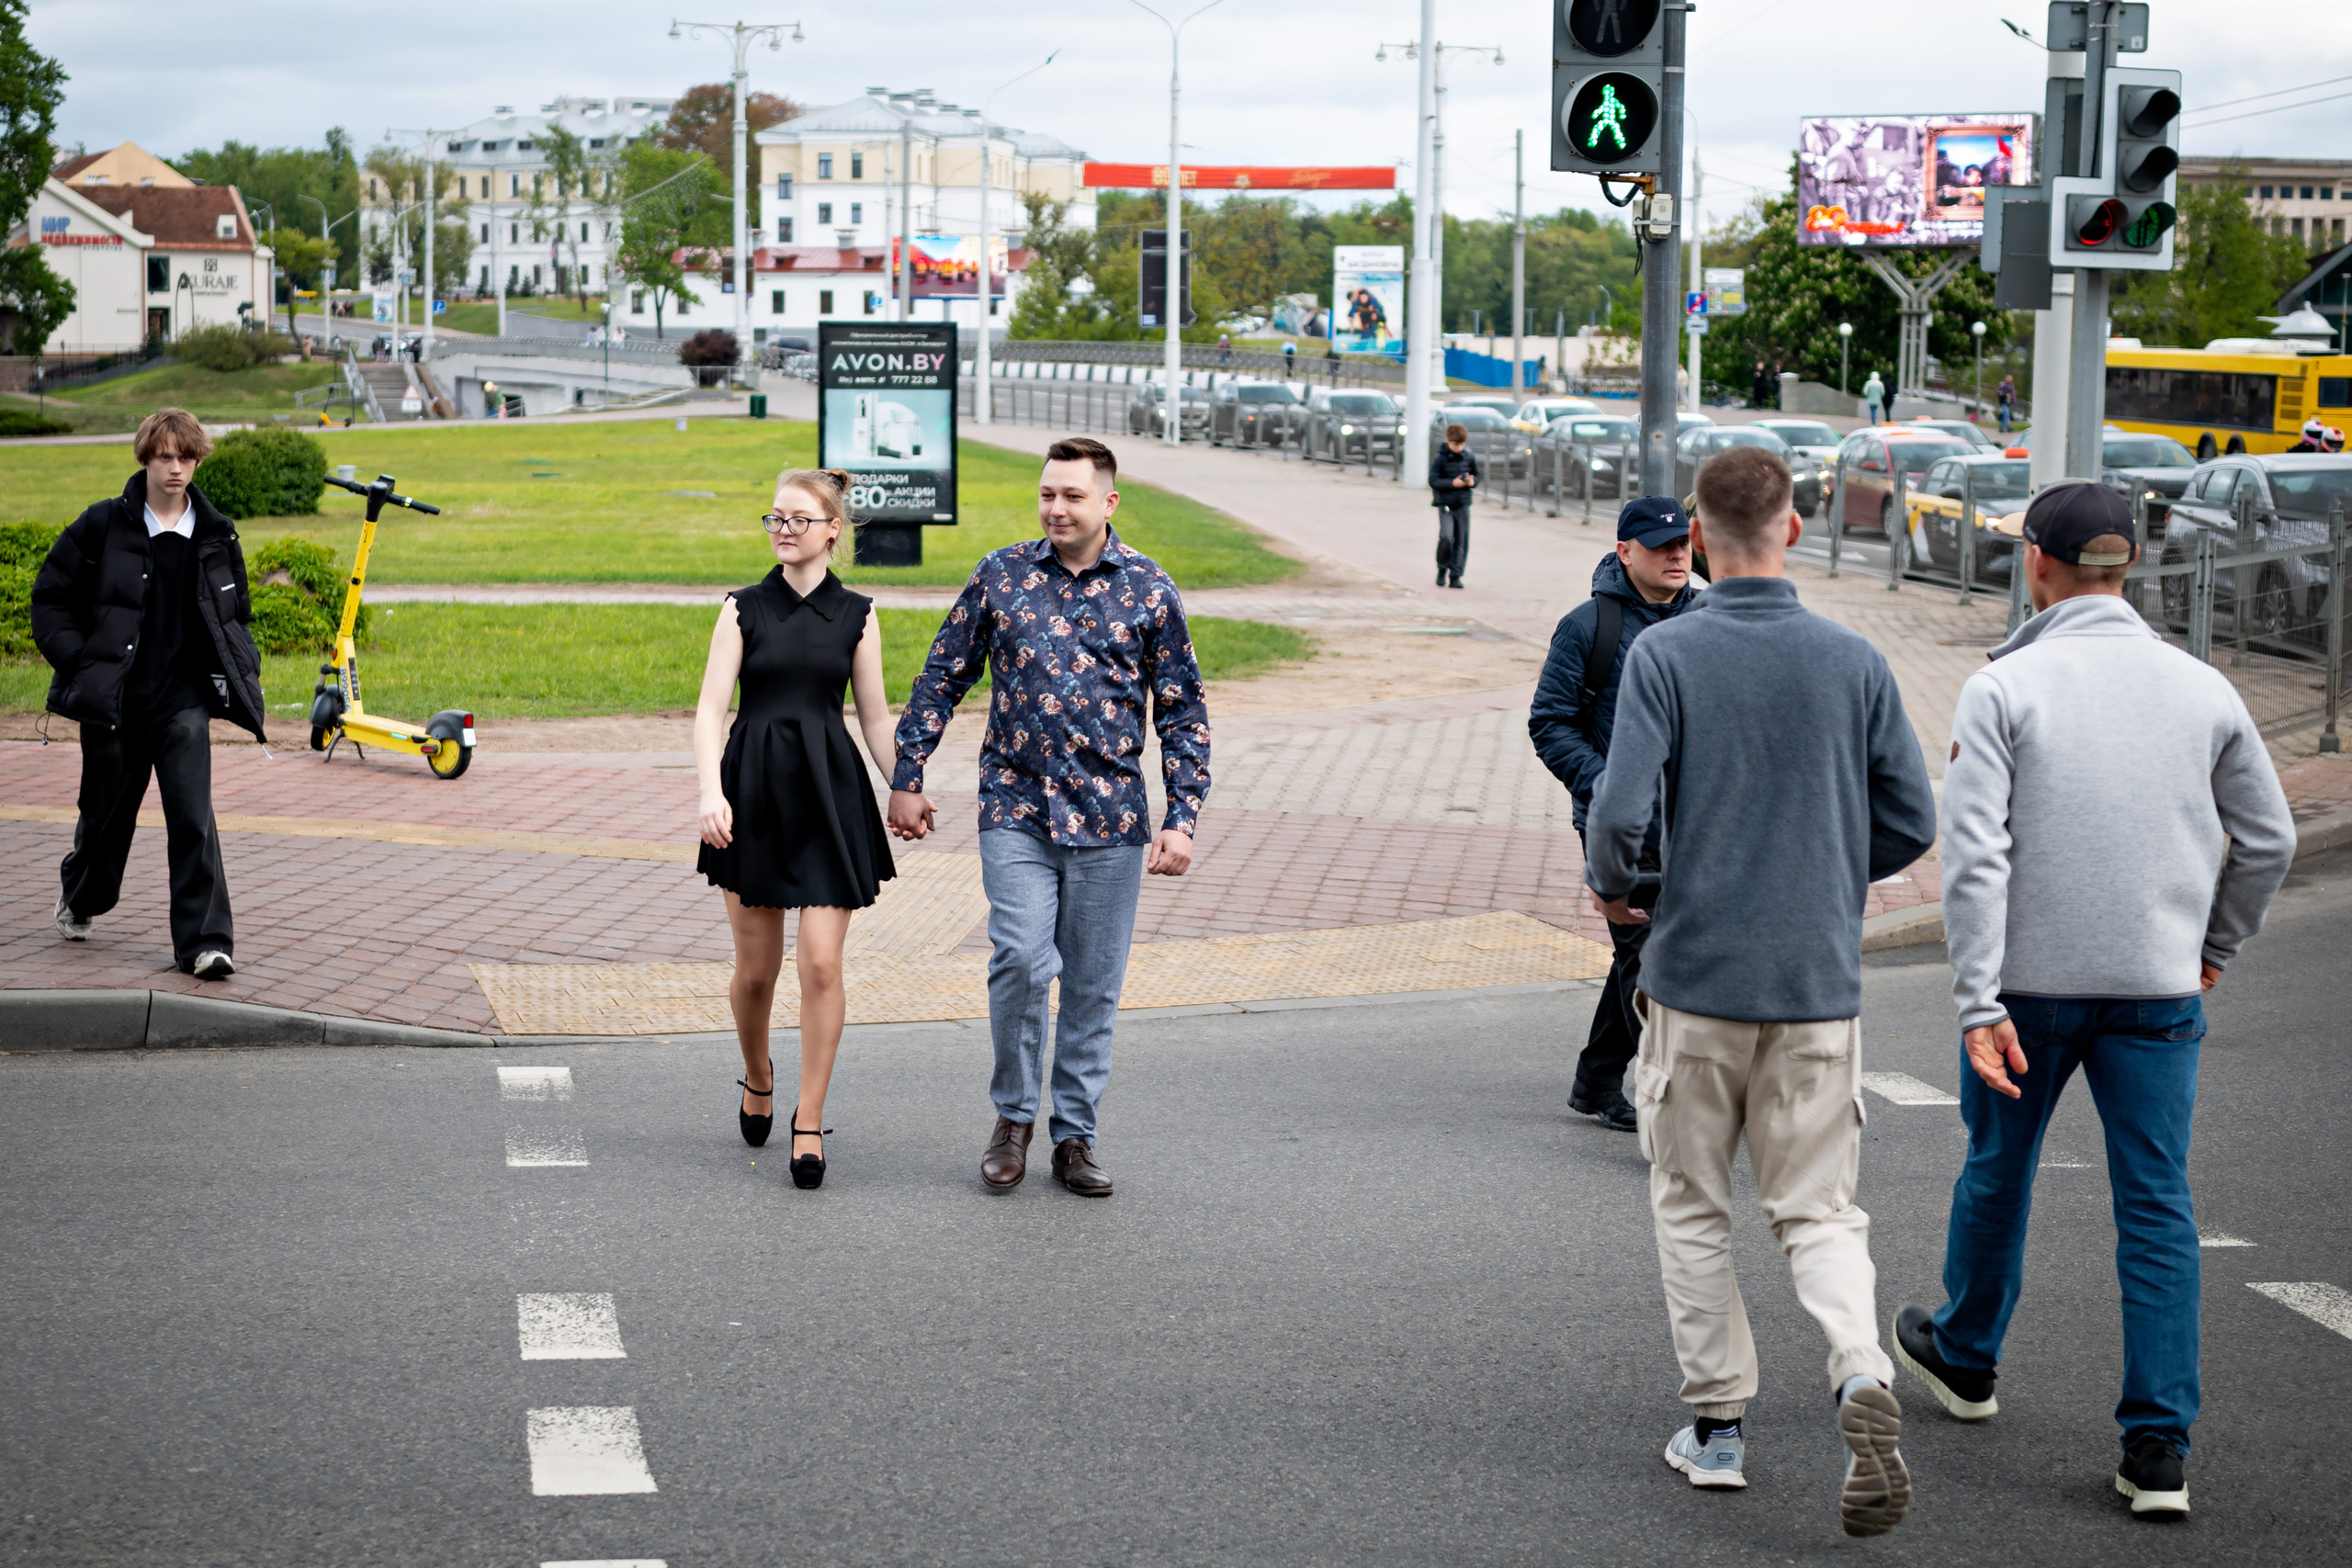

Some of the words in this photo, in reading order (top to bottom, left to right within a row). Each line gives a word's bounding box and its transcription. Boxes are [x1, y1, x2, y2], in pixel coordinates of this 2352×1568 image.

[41, 216, 71, 232] МИР
[831, 353, 945, 371] AVON.BY
[890, 375, 910, 384] 777
[910, 375, 923, 384] 22
[923, 375, 938, 384] 88
[852, 474, 910, 485] ПОДАРКИ
[893, 487, 936, 497] АКЦИИ
[887, 498, 936, 508] СКИДКИ
